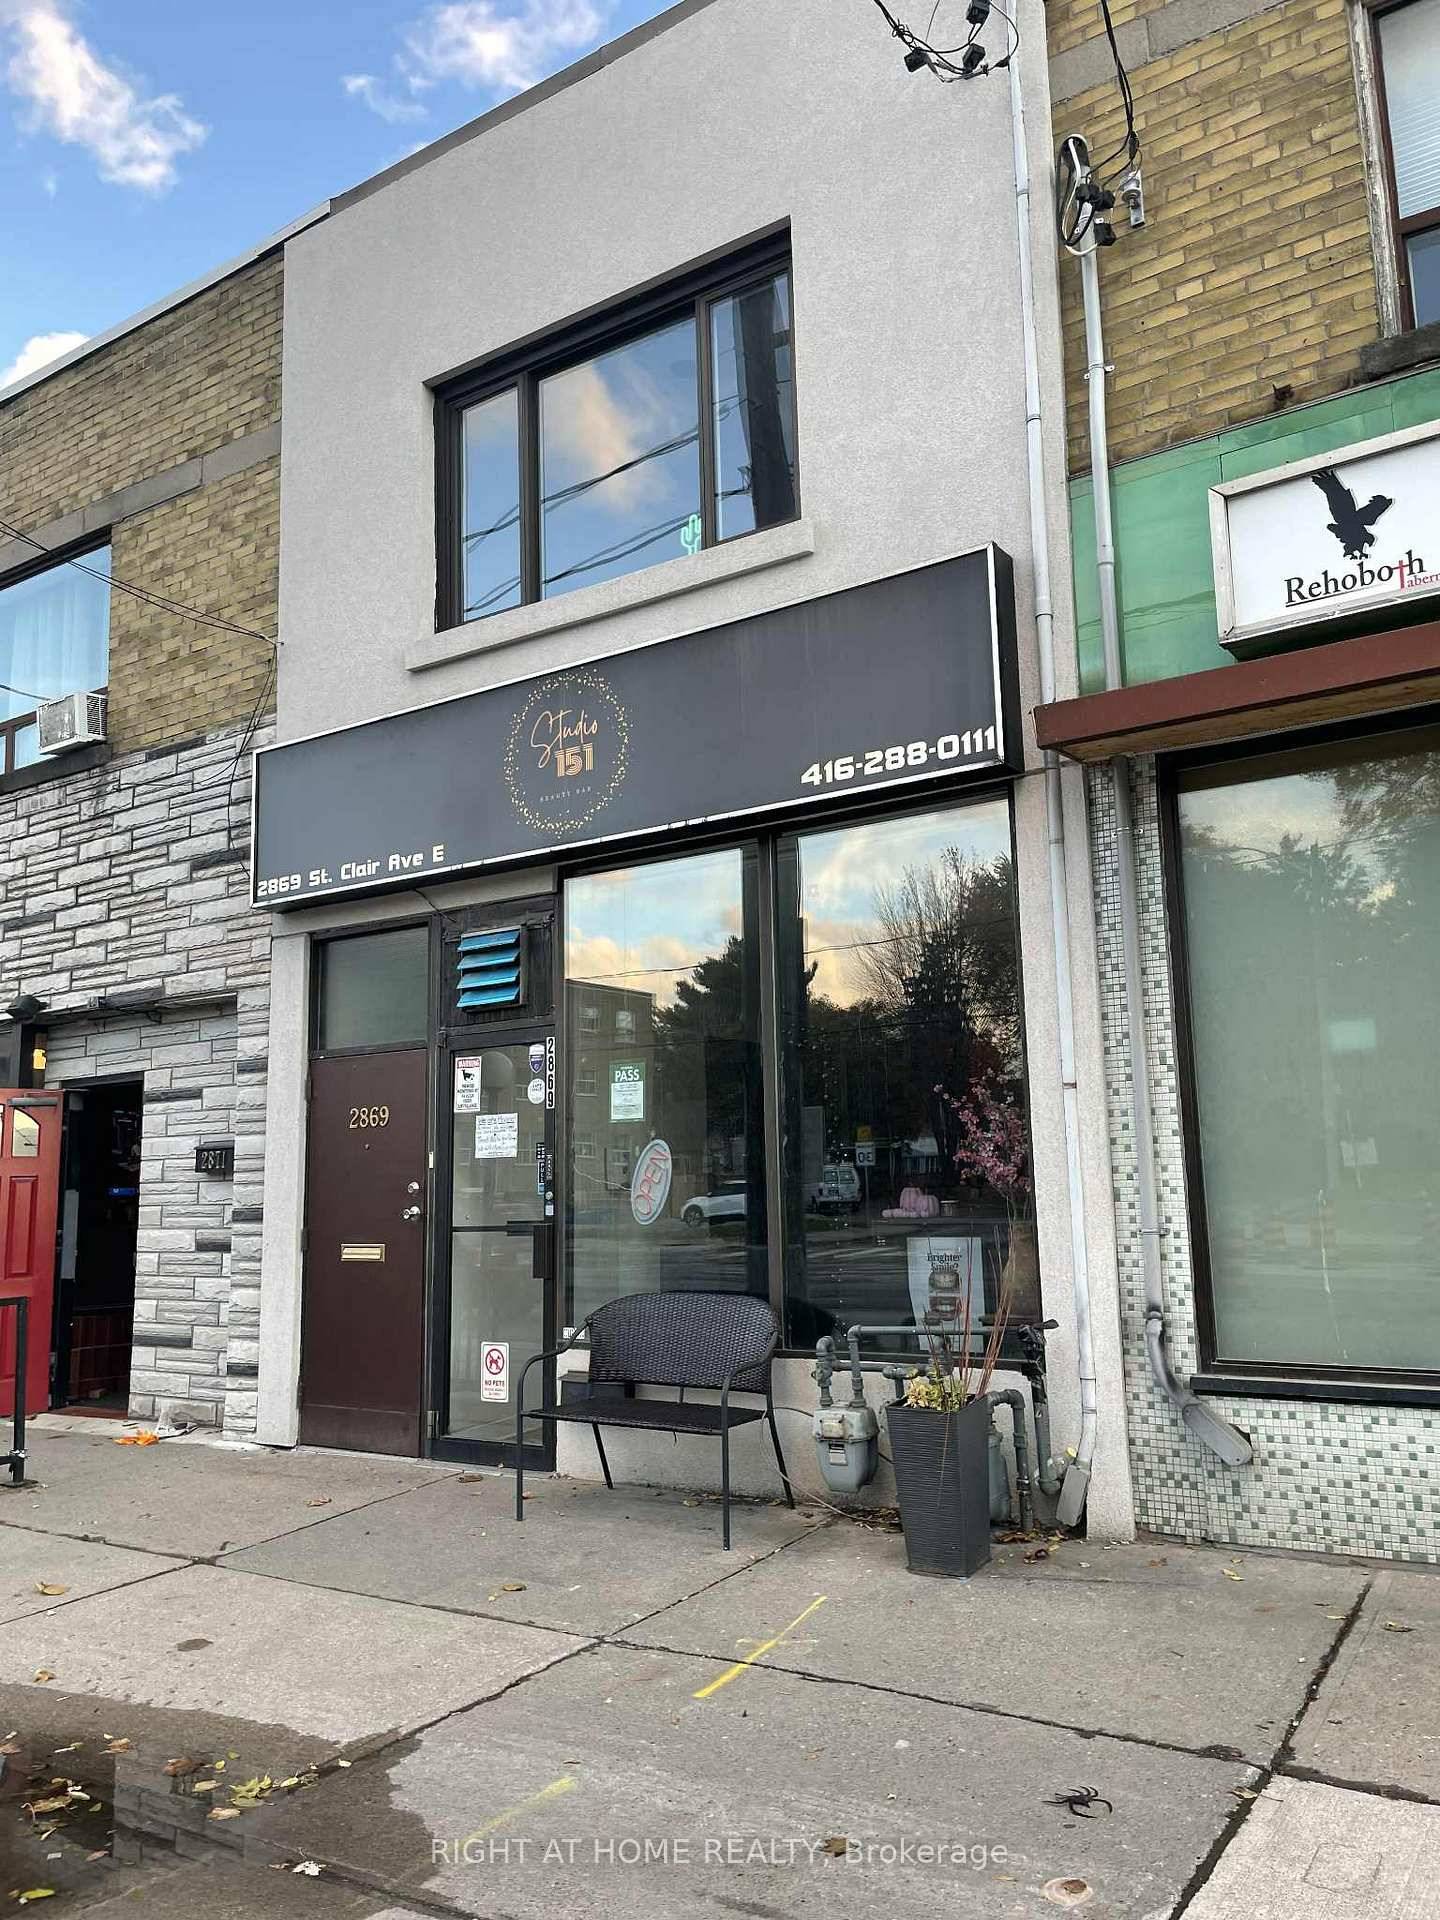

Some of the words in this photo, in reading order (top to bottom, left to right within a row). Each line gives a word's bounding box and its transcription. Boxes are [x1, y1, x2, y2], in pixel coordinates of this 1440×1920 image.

[1284, 549, 1426, 604] Rehoboth
[530, 709, 598, 769] Studio
[555, 743, 594, 777] 151
[801, 725, 996, 786] 416-288-0111
[257, 874, 302, 897] 2869
[308, 869, 333, 887] St.
[340, 859, 381, 881] Clair
[388, 852, 424, 872] Ave
[432, 844, 445, 863] E
[547, 1037, 555, 1109] 2869
[614, 1069, 640, 1082] PASS
[349, 1105, 390, 1129] 2869
